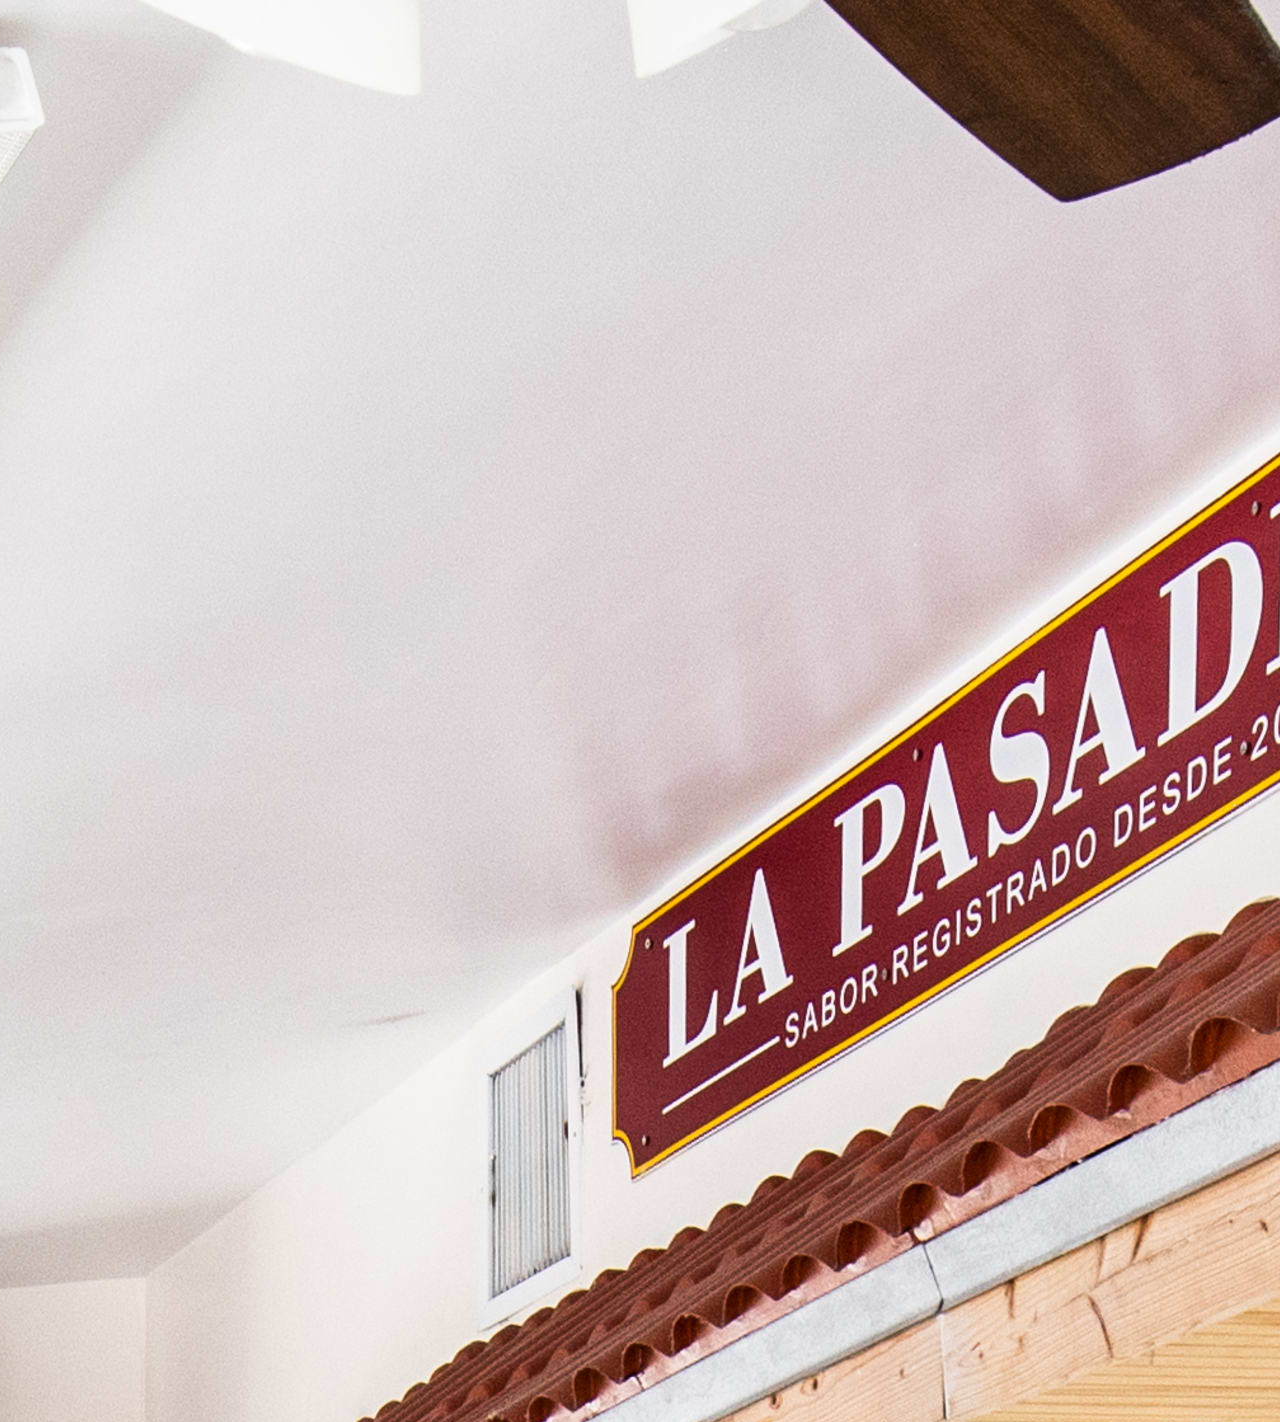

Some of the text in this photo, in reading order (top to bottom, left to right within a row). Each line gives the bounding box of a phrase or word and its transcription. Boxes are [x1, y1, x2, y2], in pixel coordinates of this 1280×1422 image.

[662, 868, 794, 1068] LA
[785, 965, 879, 1049] SABOR
[893, 827, 1097, 984] REGISTRADO
[1113, 736, 1232, 847] DESDE
